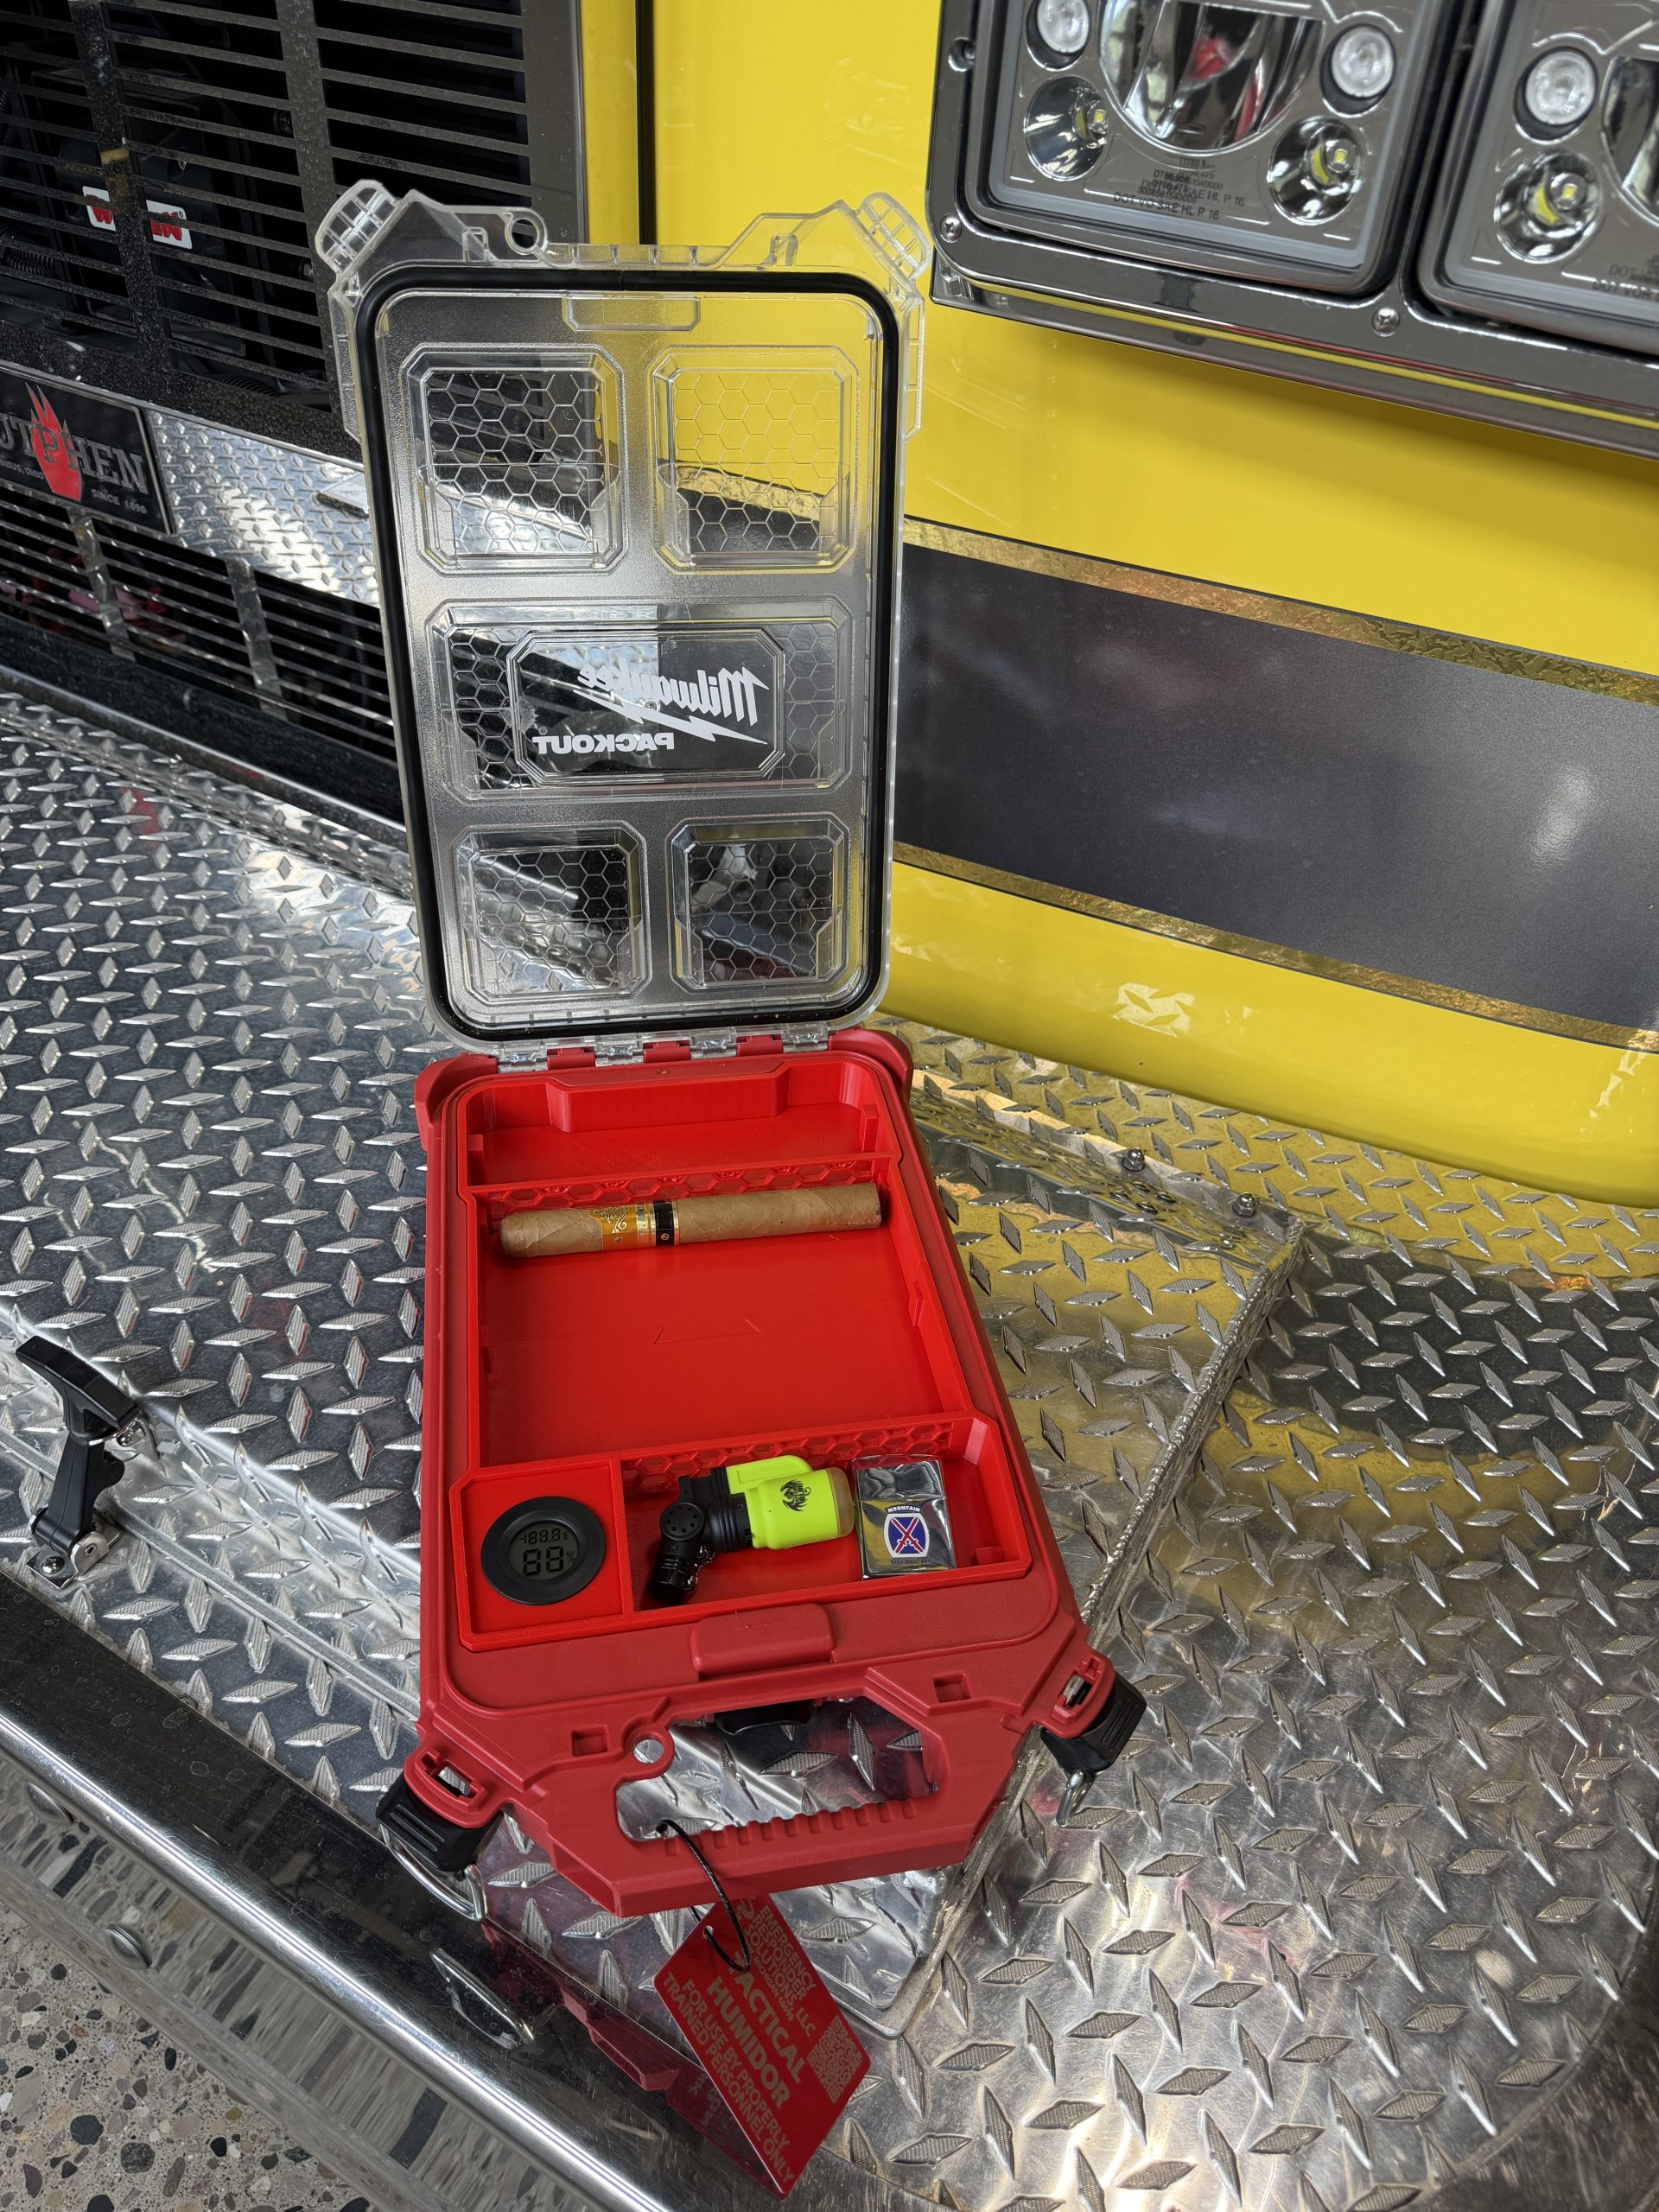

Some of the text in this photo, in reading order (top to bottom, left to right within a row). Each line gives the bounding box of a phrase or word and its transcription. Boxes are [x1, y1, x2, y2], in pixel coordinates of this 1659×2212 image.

[1113, 191, 1136, 205] DOT
[1155, 199, 1180, 213] SAE
[1180, 204, 1195, 217] HL
[1197, 207, 1205, 217] P
[1208, 208, 1220, 220] 16
[90, 488, 121, 505] SINCE
[887, 1505, 921, 1514] MOUNTAIN
[752, 1913, 807, 2002] RESPONDER
[753, 1955, 780, 1999] MICHIGAN
[760, 1904, 817, 1992] EMERGENCY
[706, 1975, 791, 2109] HUMIDOR
[795, 2006, 817, 2038] LLC
[662, 1971, 709, 2047] TRAINED
[705, 2043, 762, 2142] PERSONNEL
[762, 2137, 795, 2184] ONLY
[682, 1978, 791, 2151] FOR USE BY PROPERLY
